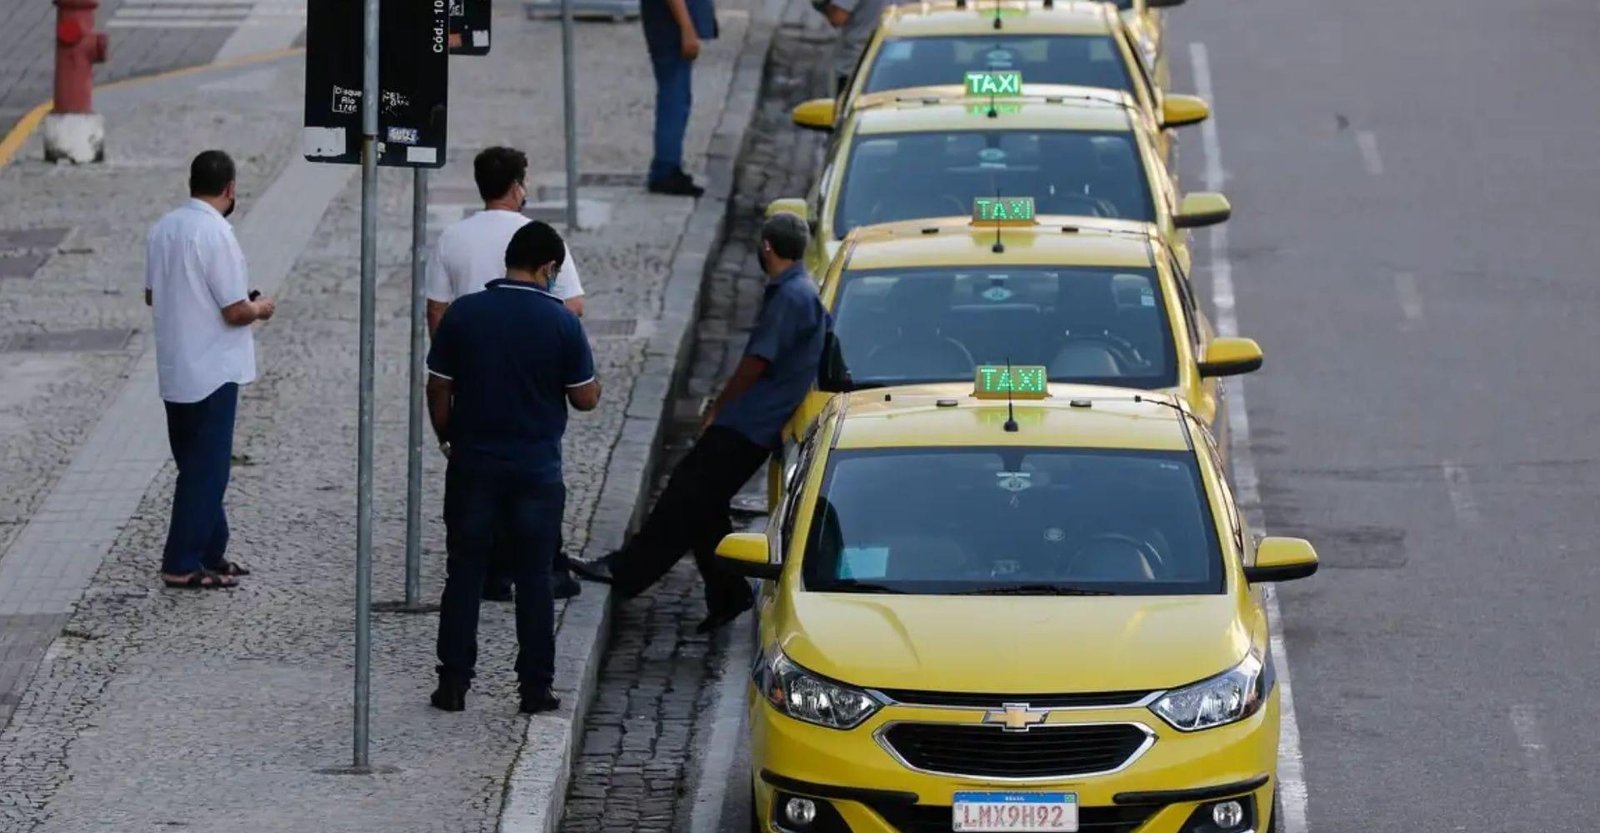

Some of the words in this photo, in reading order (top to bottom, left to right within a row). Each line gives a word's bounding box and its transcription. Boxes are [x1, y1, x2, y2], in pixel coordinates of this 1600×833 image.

[967, 74, 1018, 93] TAXI
[341, 96, 355, 104] Rio
[977, 200, 1031, 219] TAXI
[980, 368, 1042, 391] TAXI
[963, 805, 1064, 827] LMX9H92
